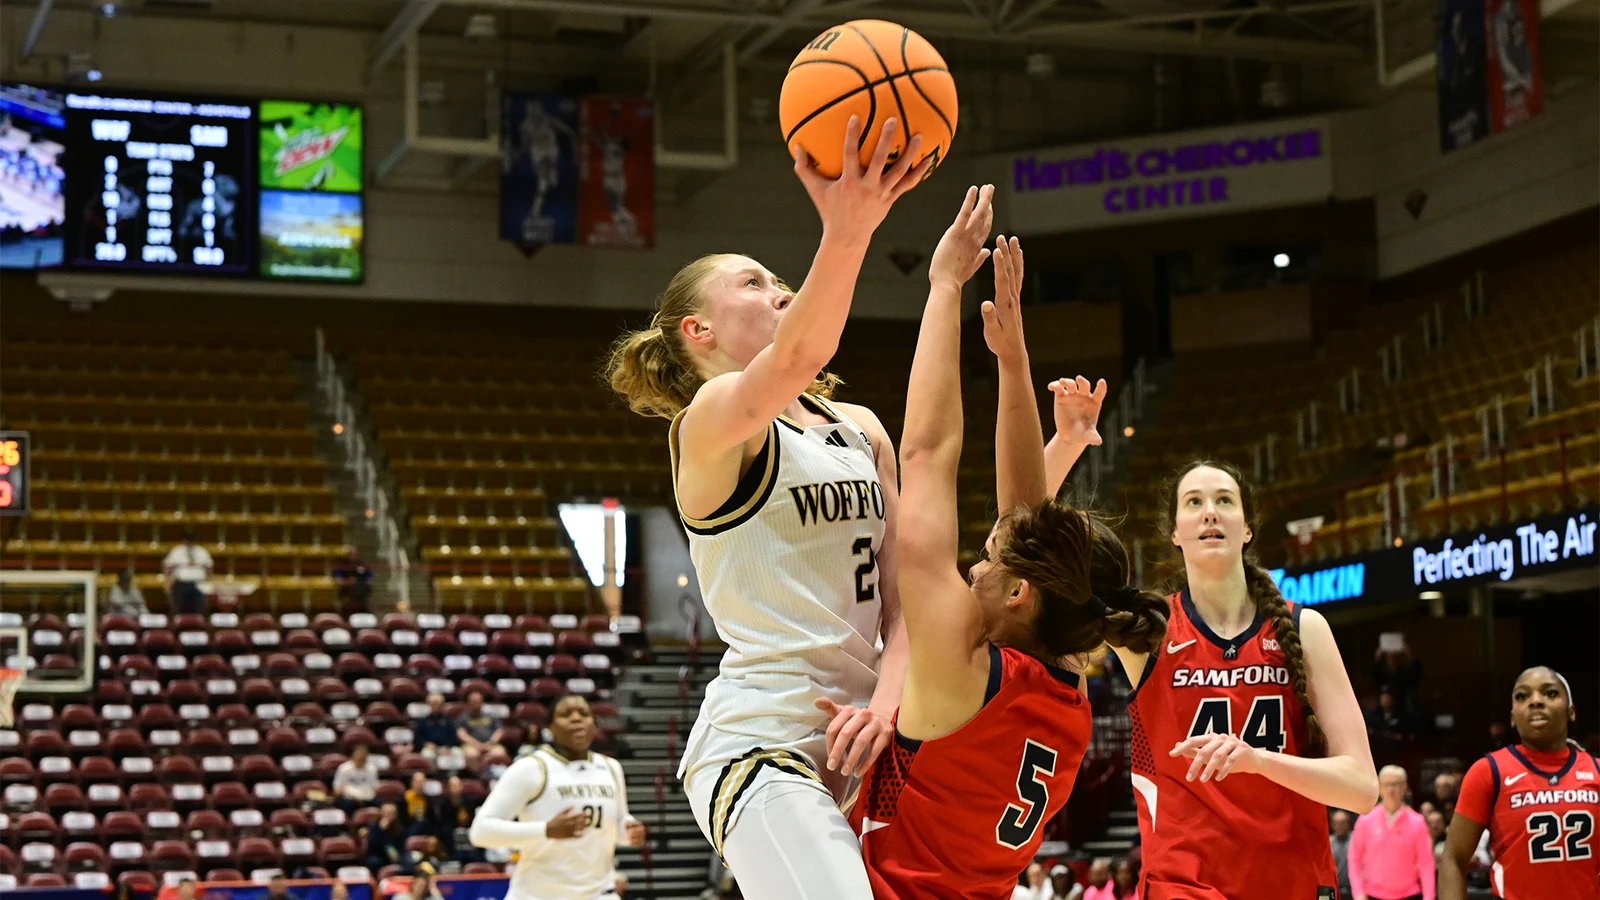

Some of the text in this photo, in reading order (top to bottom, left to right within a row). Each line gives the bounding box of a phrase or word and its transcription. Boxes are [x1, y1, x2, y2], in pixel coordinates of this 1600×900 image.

[1136, 129, 1322, 178] CHEROKEE
[1103, 176, 1230, 213] CENTER
[789, 479, 887, 527] WOFFO
[851, 535, 876, 605] 2
[1413, 512, 1597, 582] Perfecting The Air
[1280, 562, 1365, 606] DAIKIN
[1172, 665, 1290, 688] SAMFORD
[1186, 694, 1287, 754] 44
[995, 737, 1058, 851] 5
[1510, 789, 1599, 809] SAMFORD
[1526, 810, 1594, 863] 22
